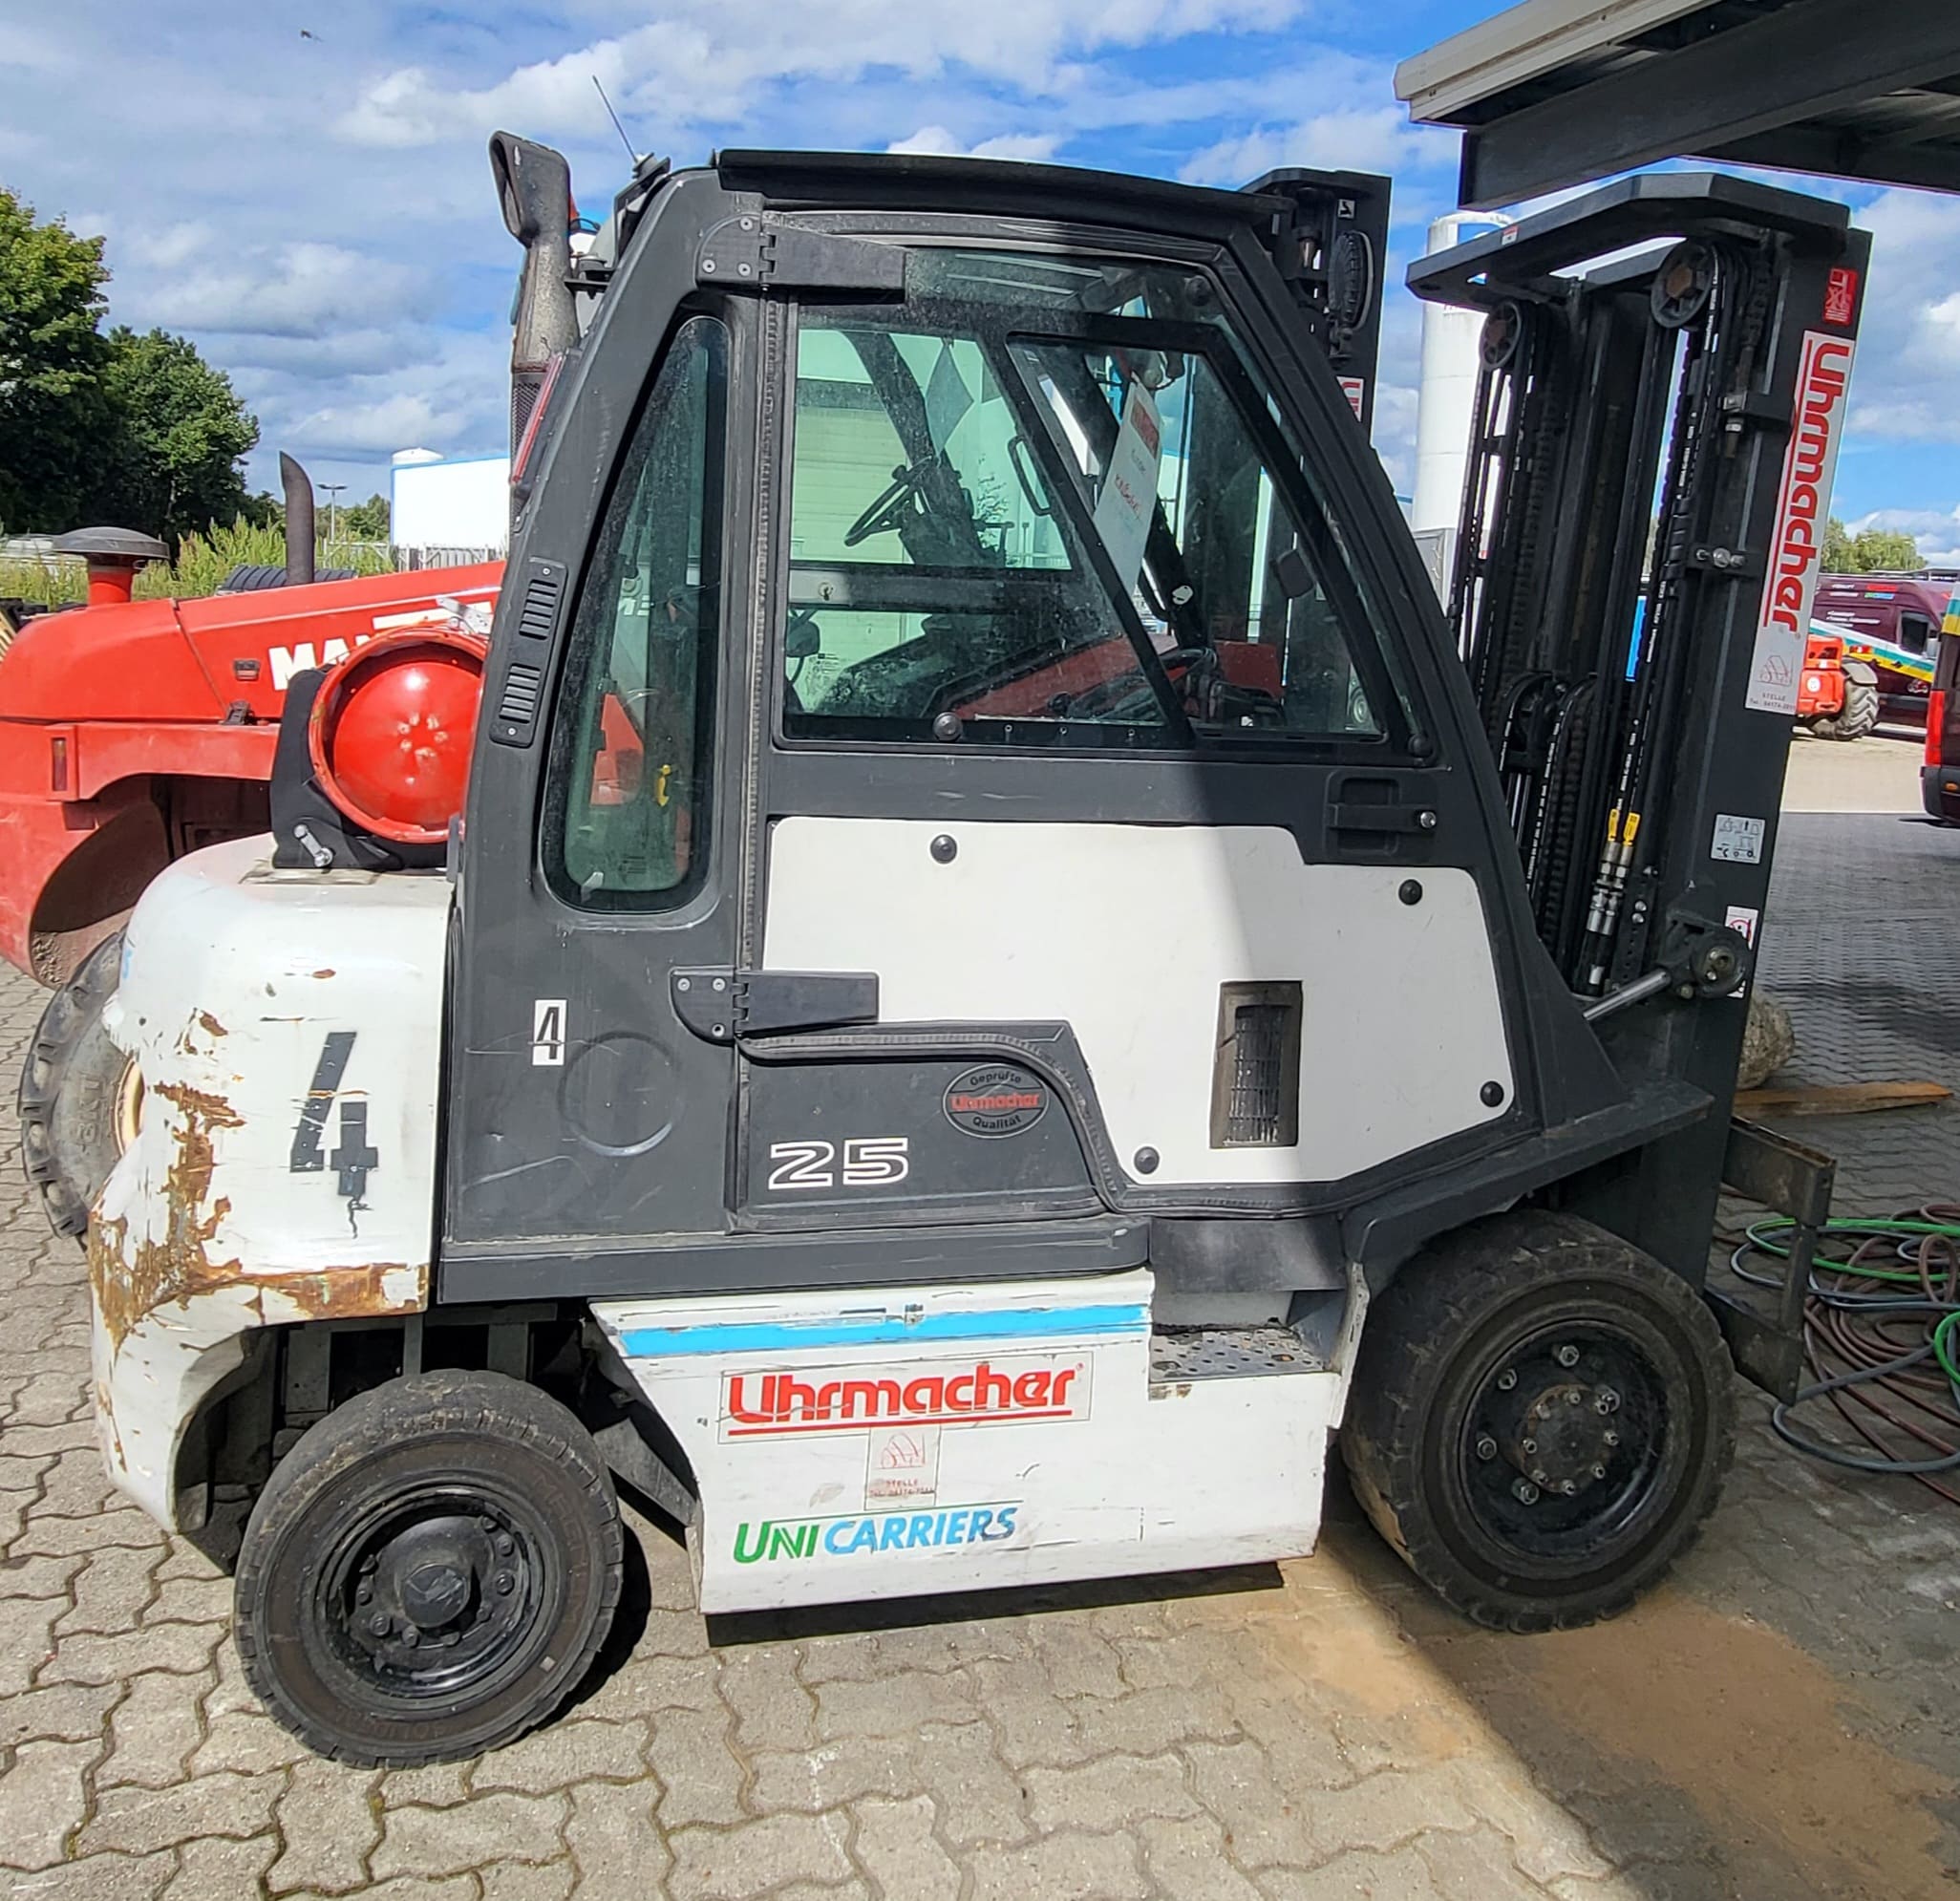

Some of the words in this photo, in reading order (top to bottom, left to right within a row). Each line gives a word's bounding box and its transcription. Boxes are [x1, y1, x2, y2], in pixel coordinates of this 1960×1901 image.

[1774, 342, 1851, 633] Uhrmacher
[534, 1006, 561, 1060] 4
[969, 1071, 1022, 1086] Geprüfte
[289, 1032, 378, 1195] 4
[972, 1115, 1022, 1129] Qualität
[767, 1137, 909, 1189] 25
[729, 1361, 1076, 1424] Uhrmacher
